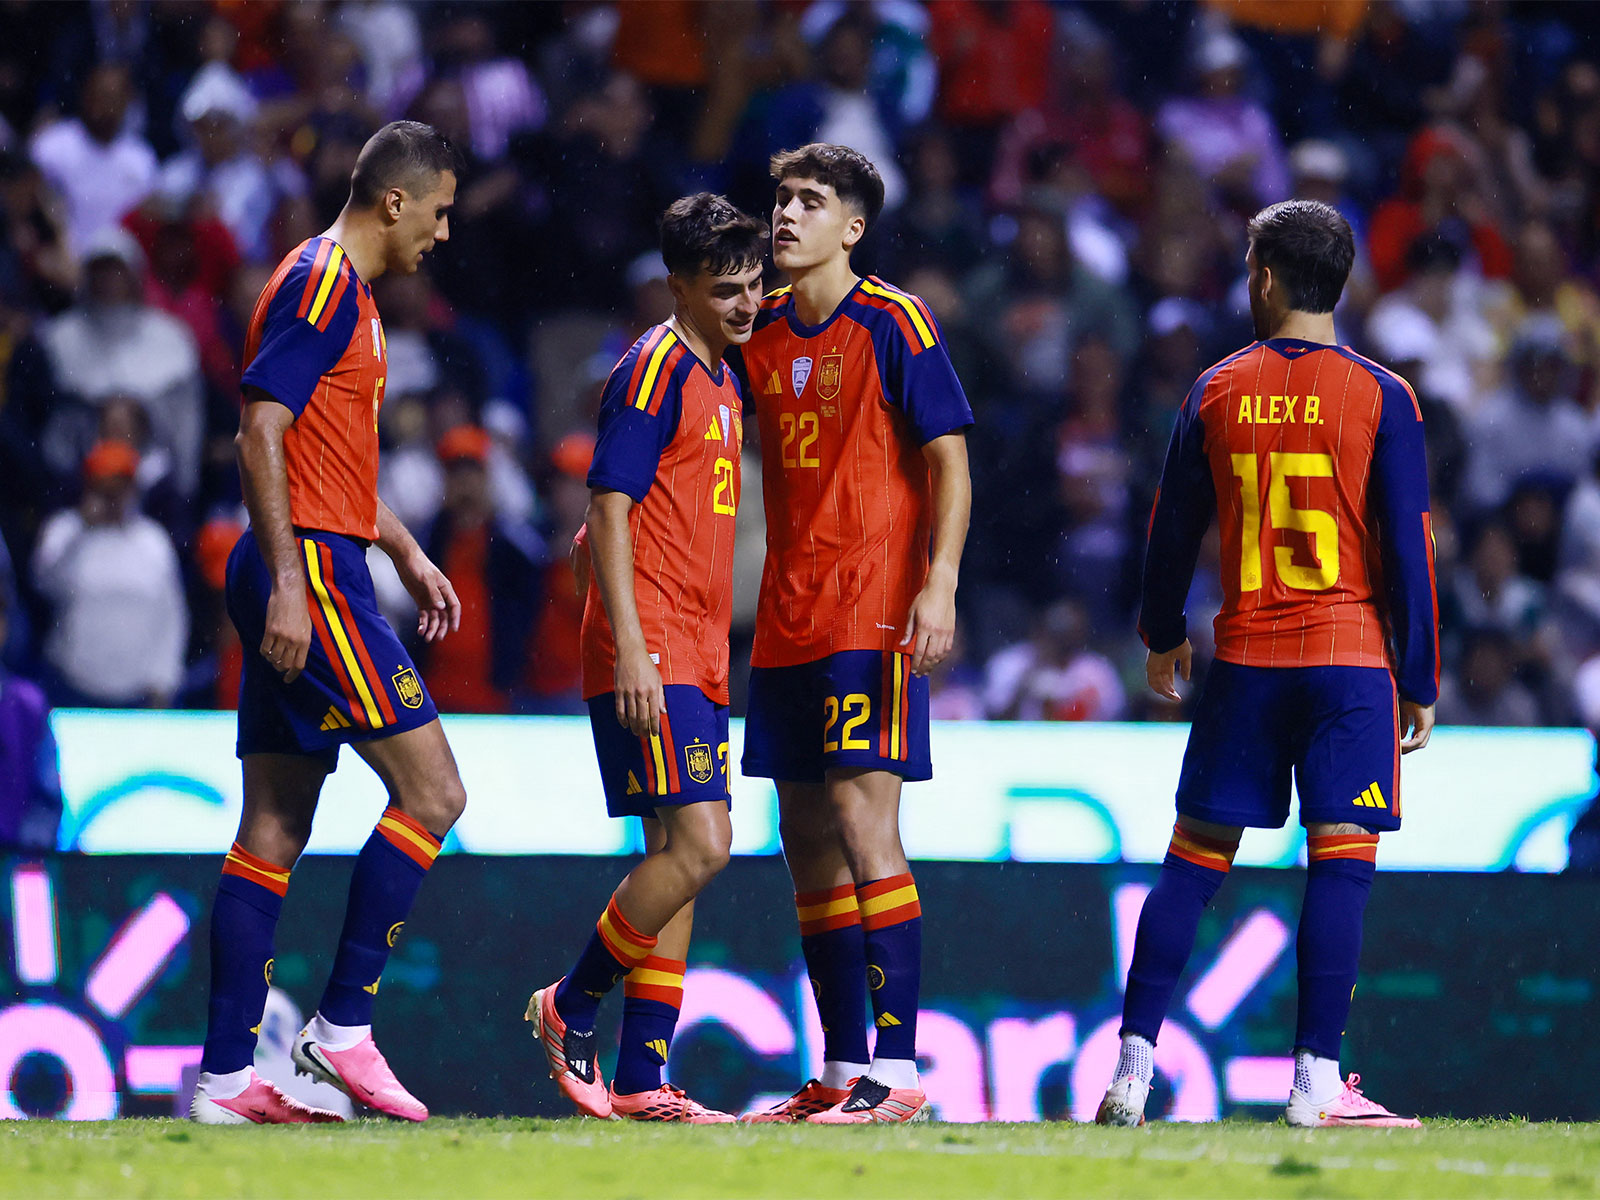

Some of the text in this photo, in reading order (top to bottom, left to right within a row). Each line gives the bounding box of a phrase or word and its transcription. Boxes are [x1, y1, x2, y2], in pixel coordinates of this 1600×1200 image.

[1237, 395, 1324, 425] ALEX B.
[779, 411, 820, 468] 22
[1230, 452, 1340, 592] 15
[823, 693, 871, 753] 22
